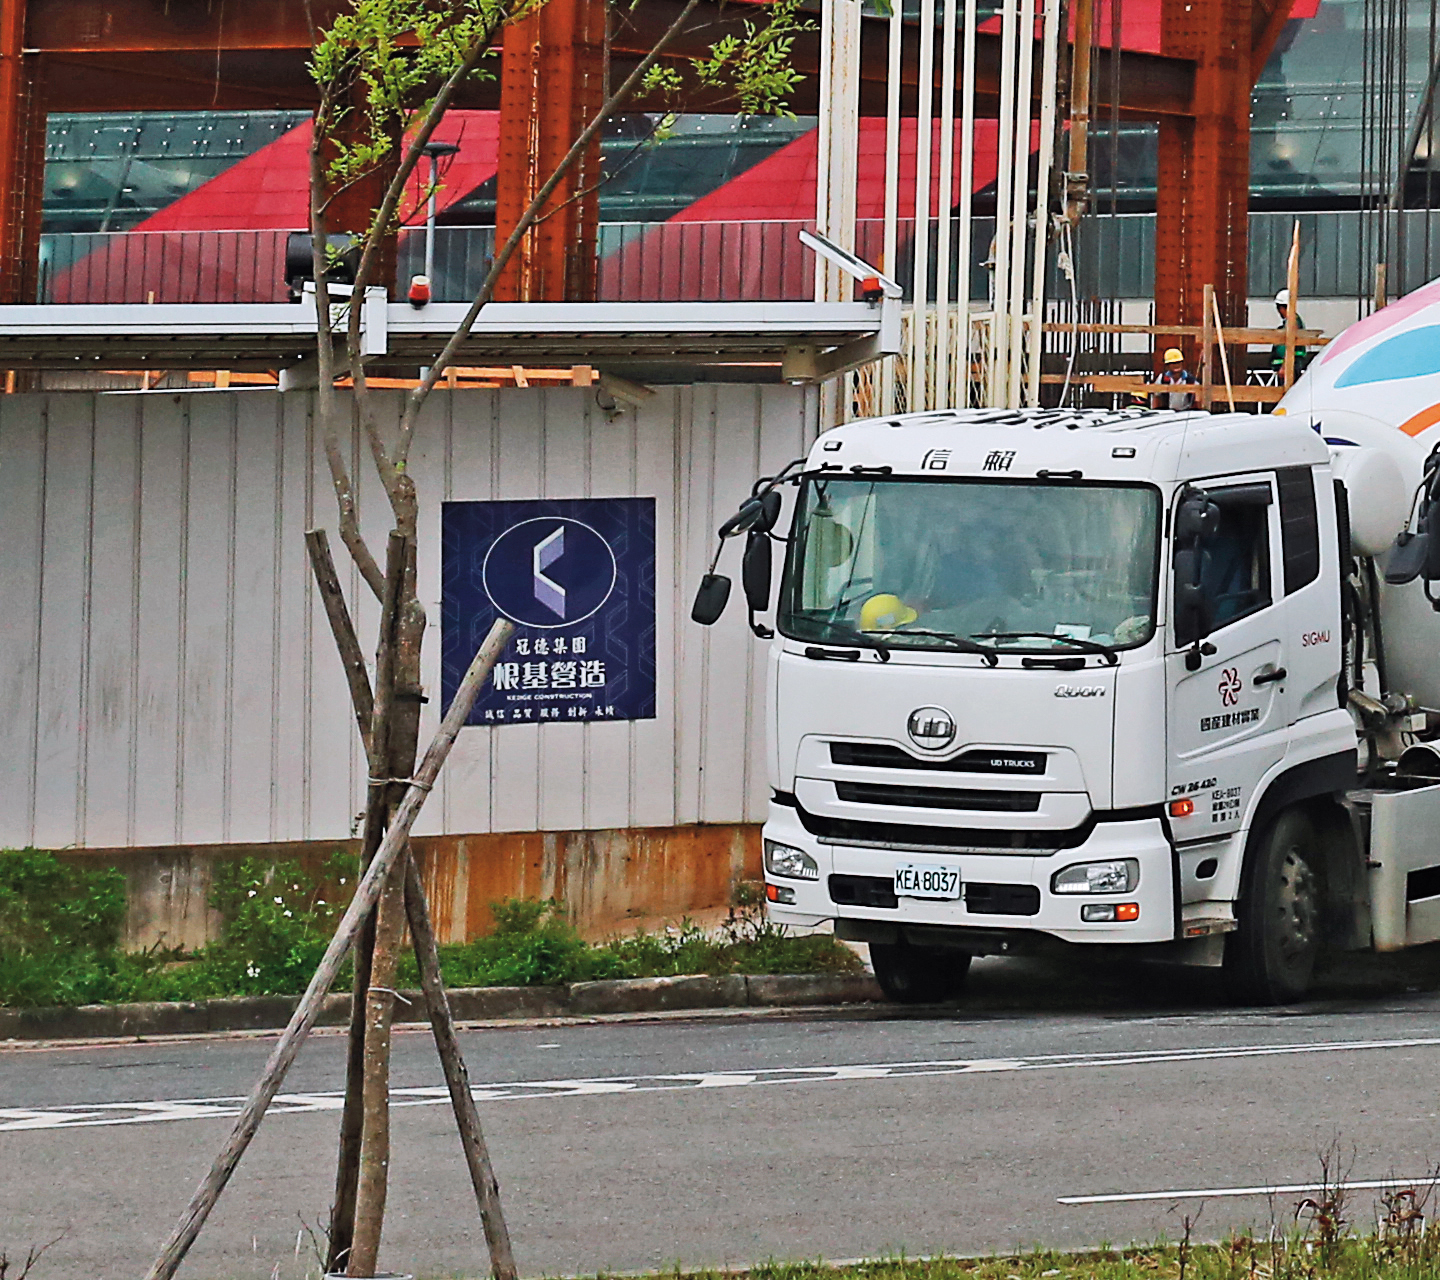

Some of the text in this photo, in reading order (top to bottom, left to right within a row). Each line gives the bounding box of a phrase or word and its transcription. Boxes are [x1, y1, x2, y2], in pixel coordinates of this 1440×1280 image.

[920, 447, 1018, 472] 信賴
[515, 636, 586, 656] 冠德集團
[493, 660, 606, 690] 根基營造
[990, 759, 1035, 768] UD TRUCKS
